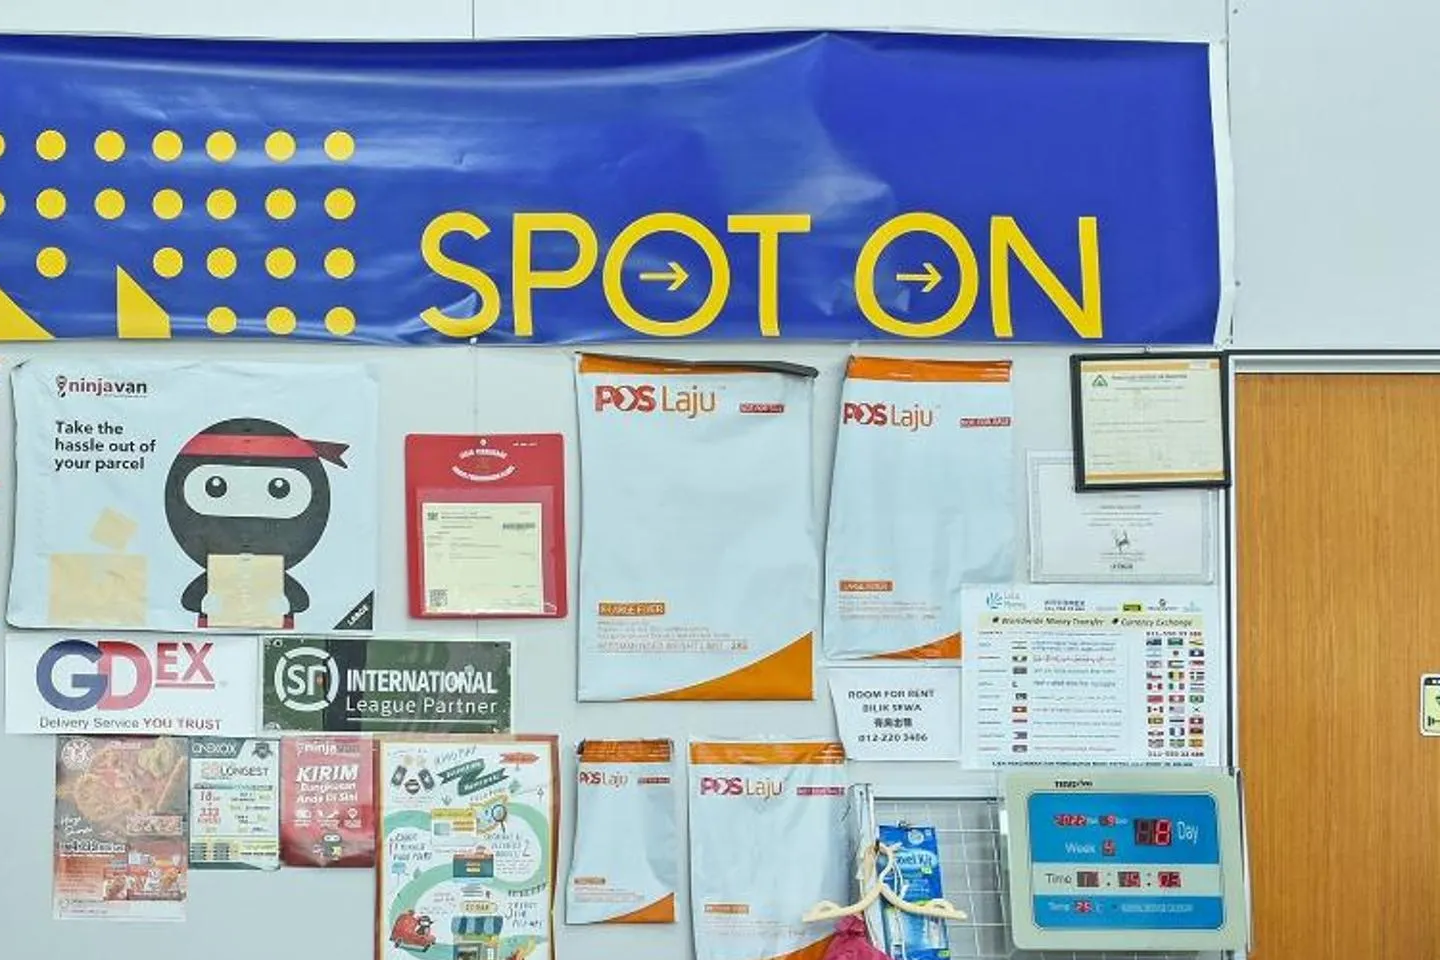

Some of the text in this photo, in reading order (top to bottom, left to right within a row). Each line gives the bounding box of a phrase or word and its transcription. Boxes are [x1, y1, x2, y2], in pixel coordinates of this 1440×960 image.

[420, 212, 1104, 338] SPOT ON
[67, 376, 148, 397] ninjavan
[594, 385, 717, 419] POS Laju
[843, 403, 933, 432] POS Laju
[55, 420, 124, 435] Take the
[55, 437, 156, 453] hassle out of
[54, 456, 146, 473] your parcel
[35, 638, 215, 712] GDEX
[346, 668, 498, 694] INTERNATIONAL
[848, 689, 935, 699] ROOM FOR RENT
[346, 697, 498, 715] League Partner
[862, 703, 923, 713] BILIK SEWA
[39, 717, 221, 731] Delivery Service YOU TRUST
[296, 764, 359, 783] KIRIM
[700, 777, 744, 796] POS
[746, 777, 783, 801] Laju
[1176, 820, 1199, 844] Day
[1064, 842, 1096, 854] Week
[1045, 872, 1072, 884] Time
